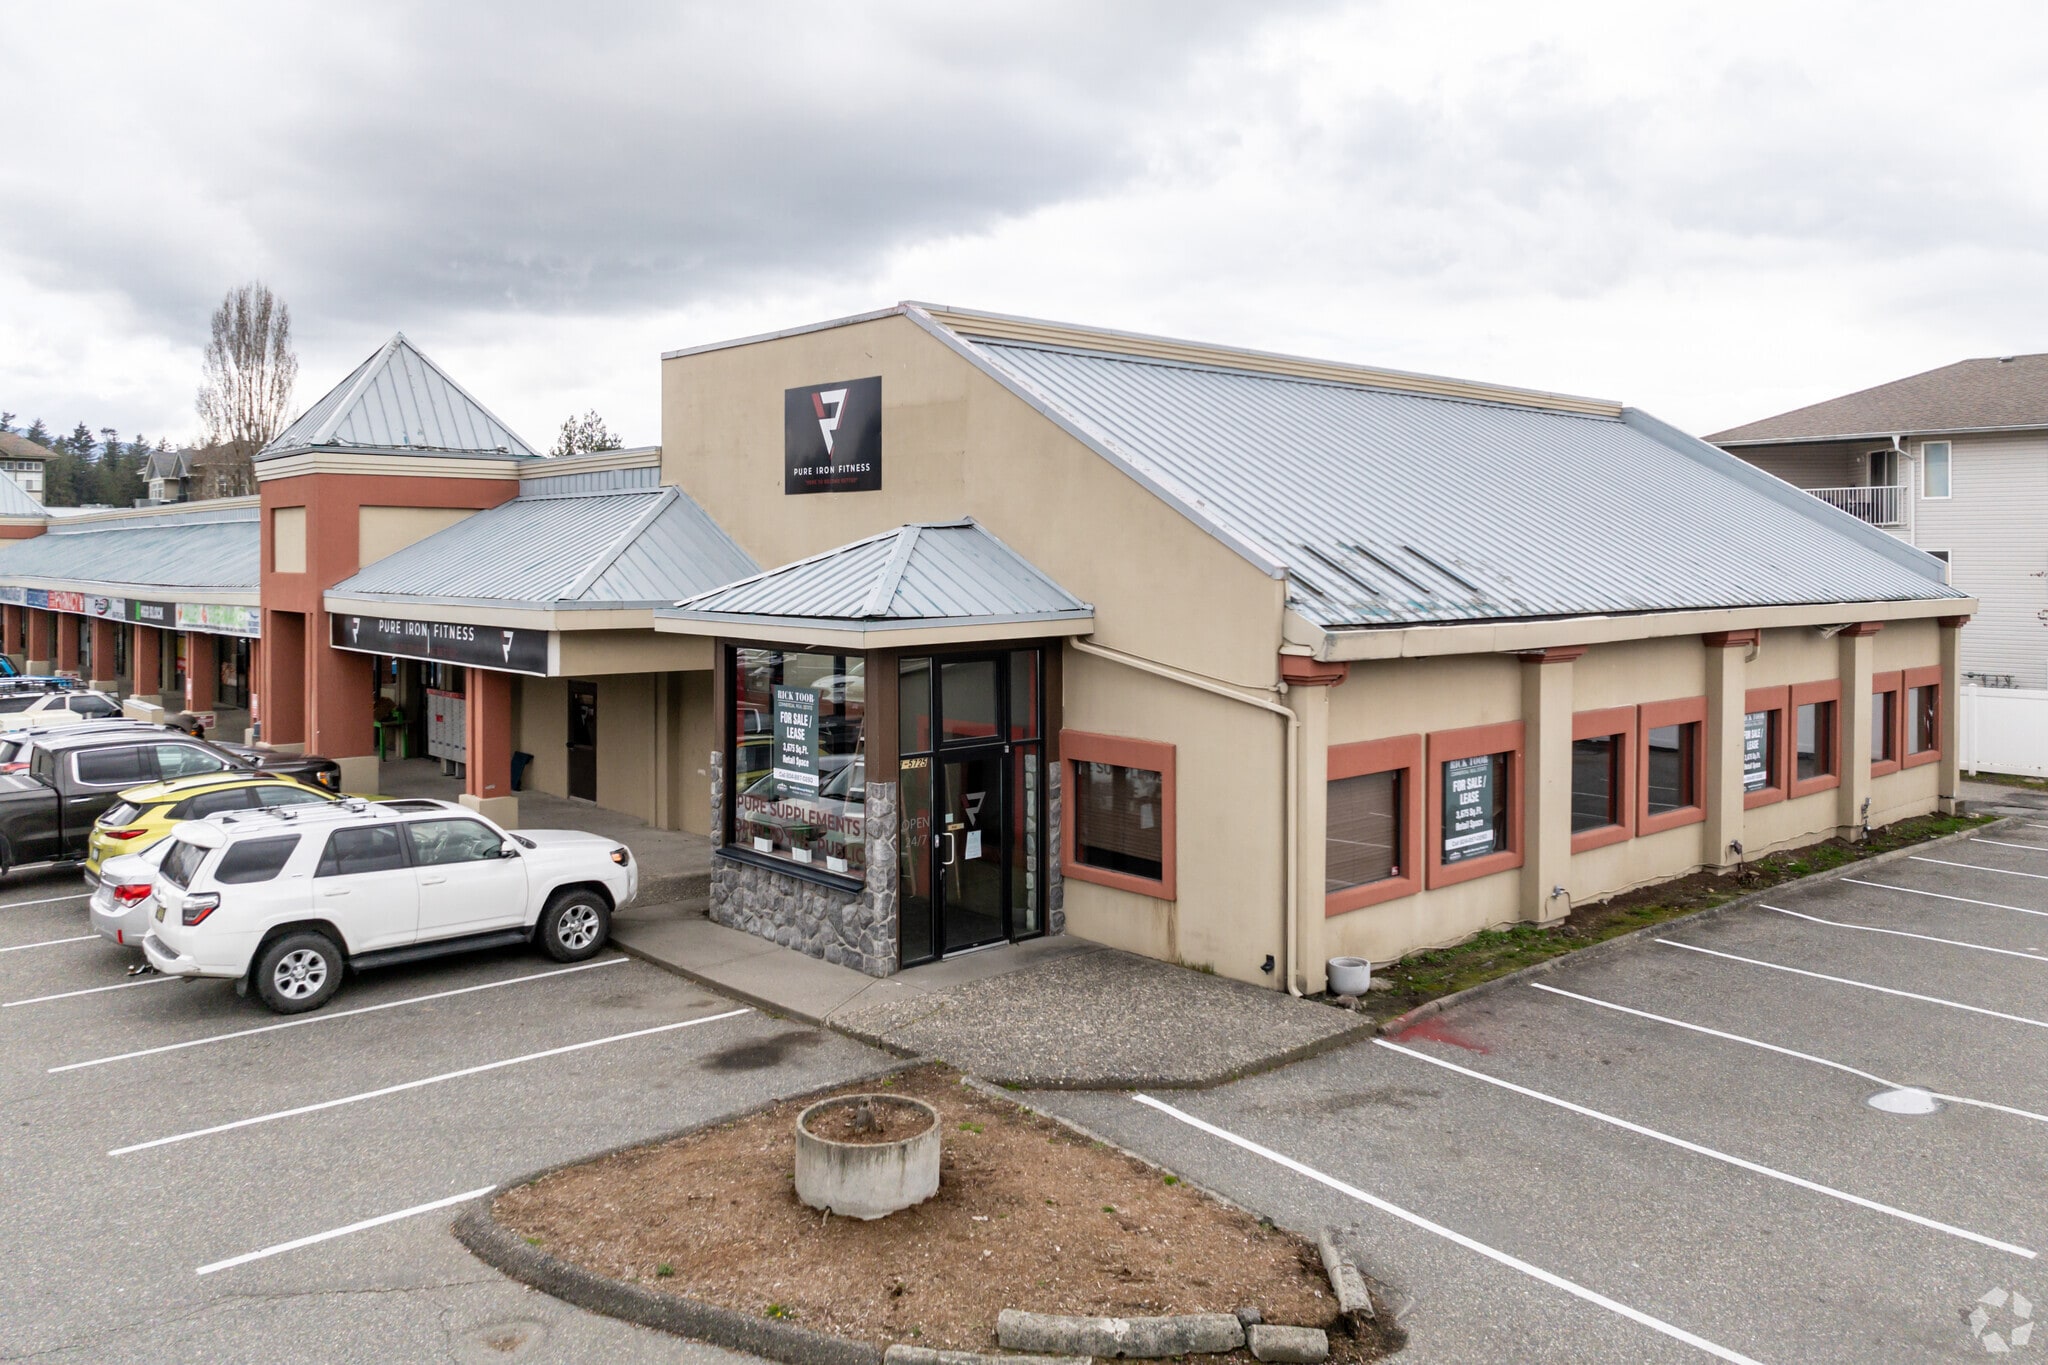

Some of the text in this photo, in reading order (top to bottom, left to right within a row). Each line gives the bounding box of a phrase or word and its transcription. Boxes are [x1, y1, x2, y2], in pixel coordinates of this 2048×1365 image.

[793, 463, 871, 476] PURE IRON FITNESS
[378, 619, 475, 642] PURE IRON FITNESS
[780, 711, 793, 724] FOR
[793, 712, 809, 727] SALE
[786, 726, 806, 741] LEASE
[783, 754, 810, 768] Retail Space
[1453, 779, 1467, 792] FOR
[1467, 775, 1483, 790] SALE
[1460, 790, 1480, 805] LEASE
[736, 794, 860, 837] PURE SUPPLEMENTS
[901, 815, 931, 832] OPEN
[905, 834, 928, 849] 24/7
